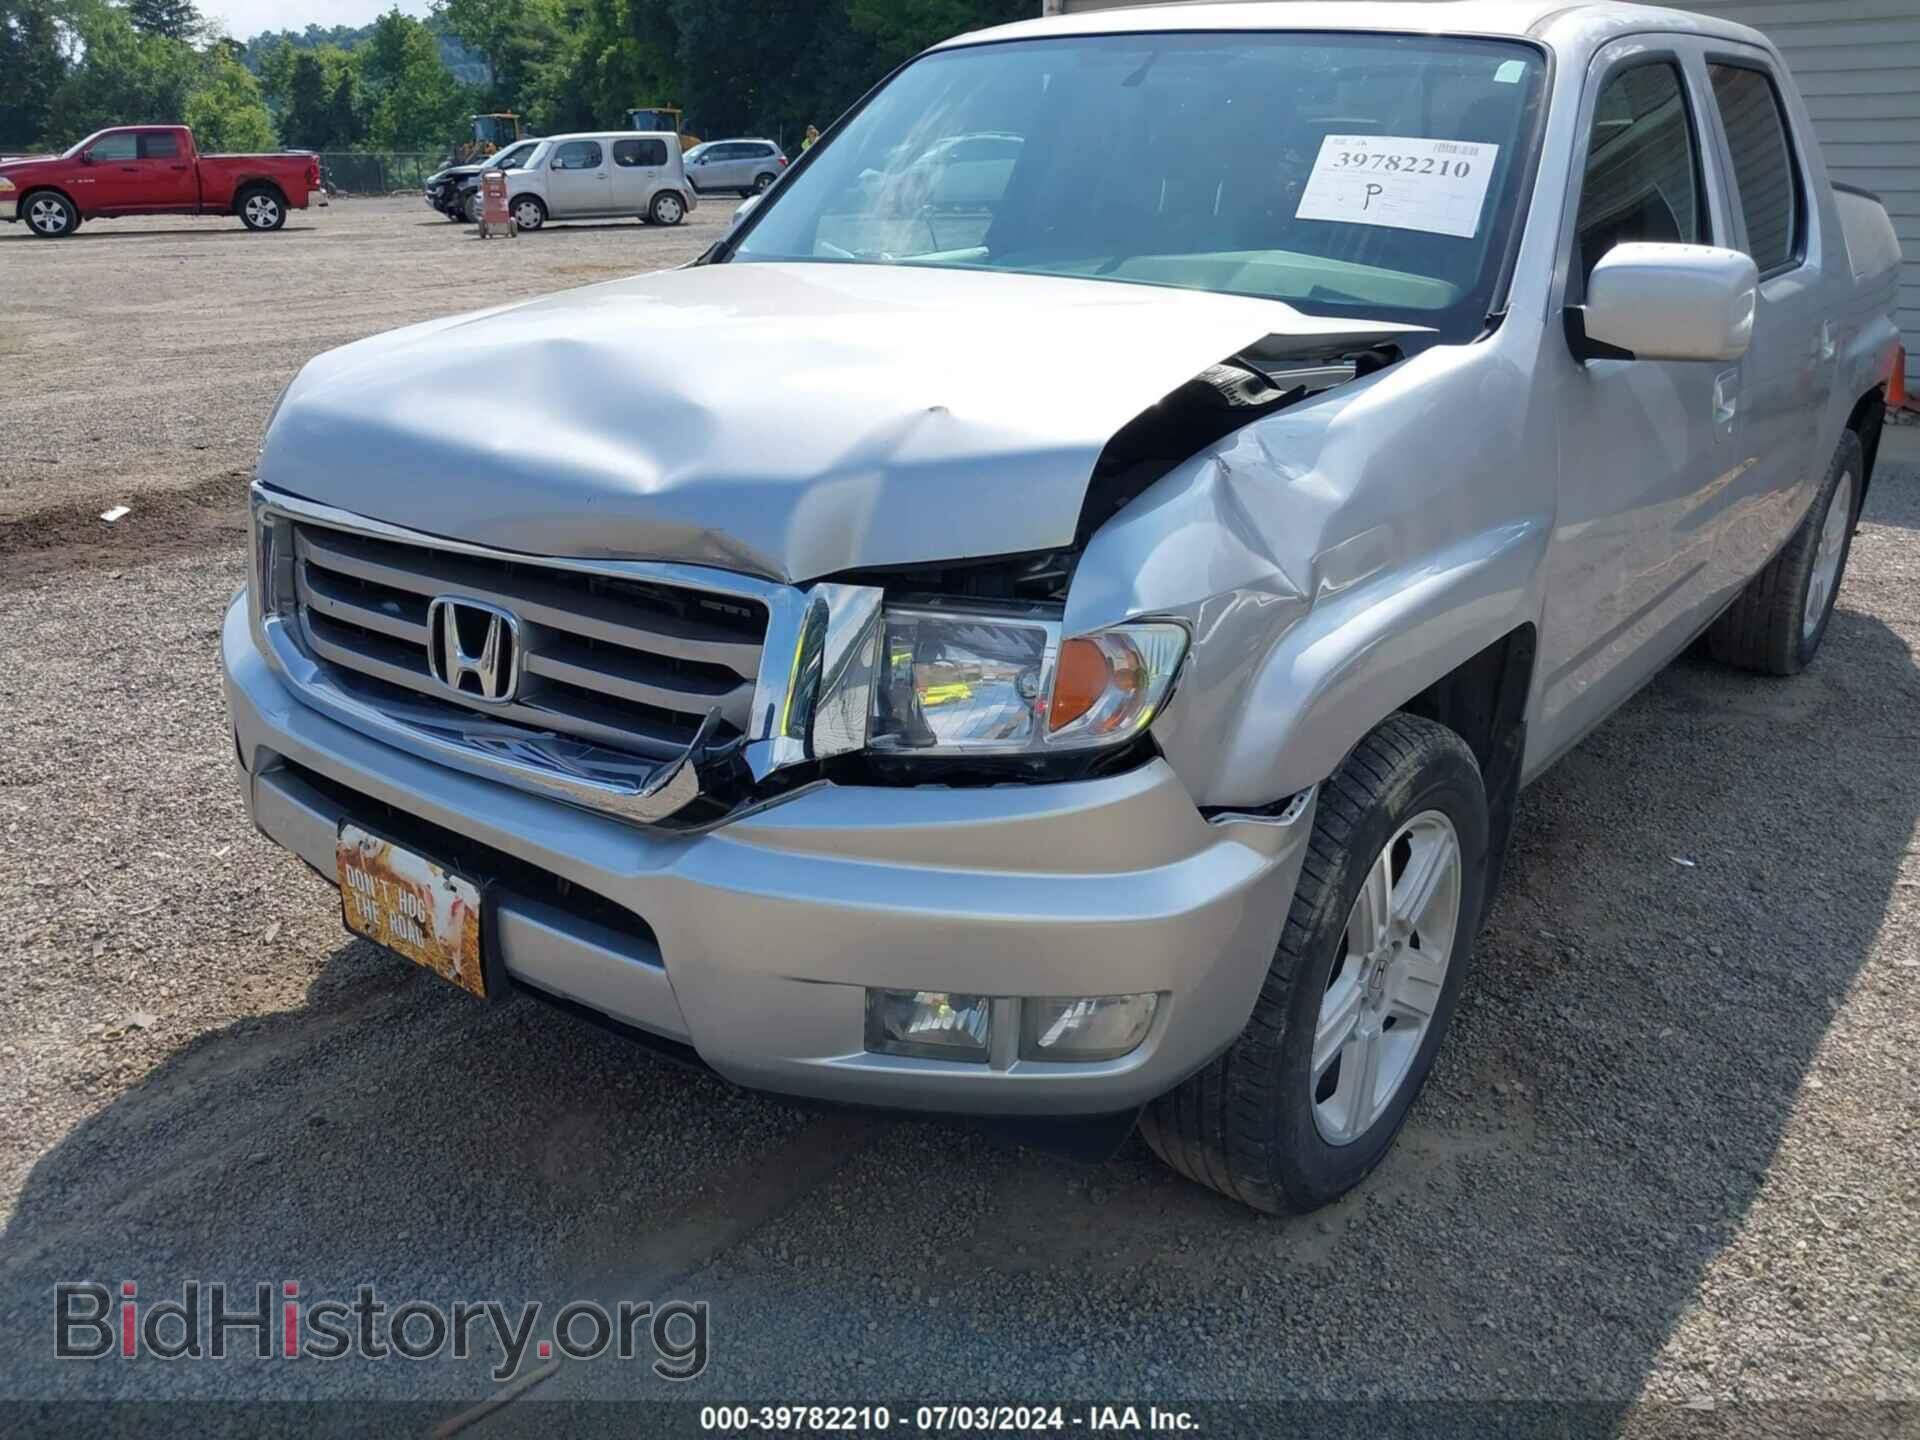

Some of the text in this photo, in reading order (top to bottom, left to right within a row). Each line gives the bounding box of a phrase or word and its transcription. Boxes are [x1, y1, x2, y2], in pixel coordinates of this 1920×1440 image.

[1333, 151, 1471, 178] 39782210
[353, 892, 381, 925] THE
[397, 886, 426, 923] HOG
